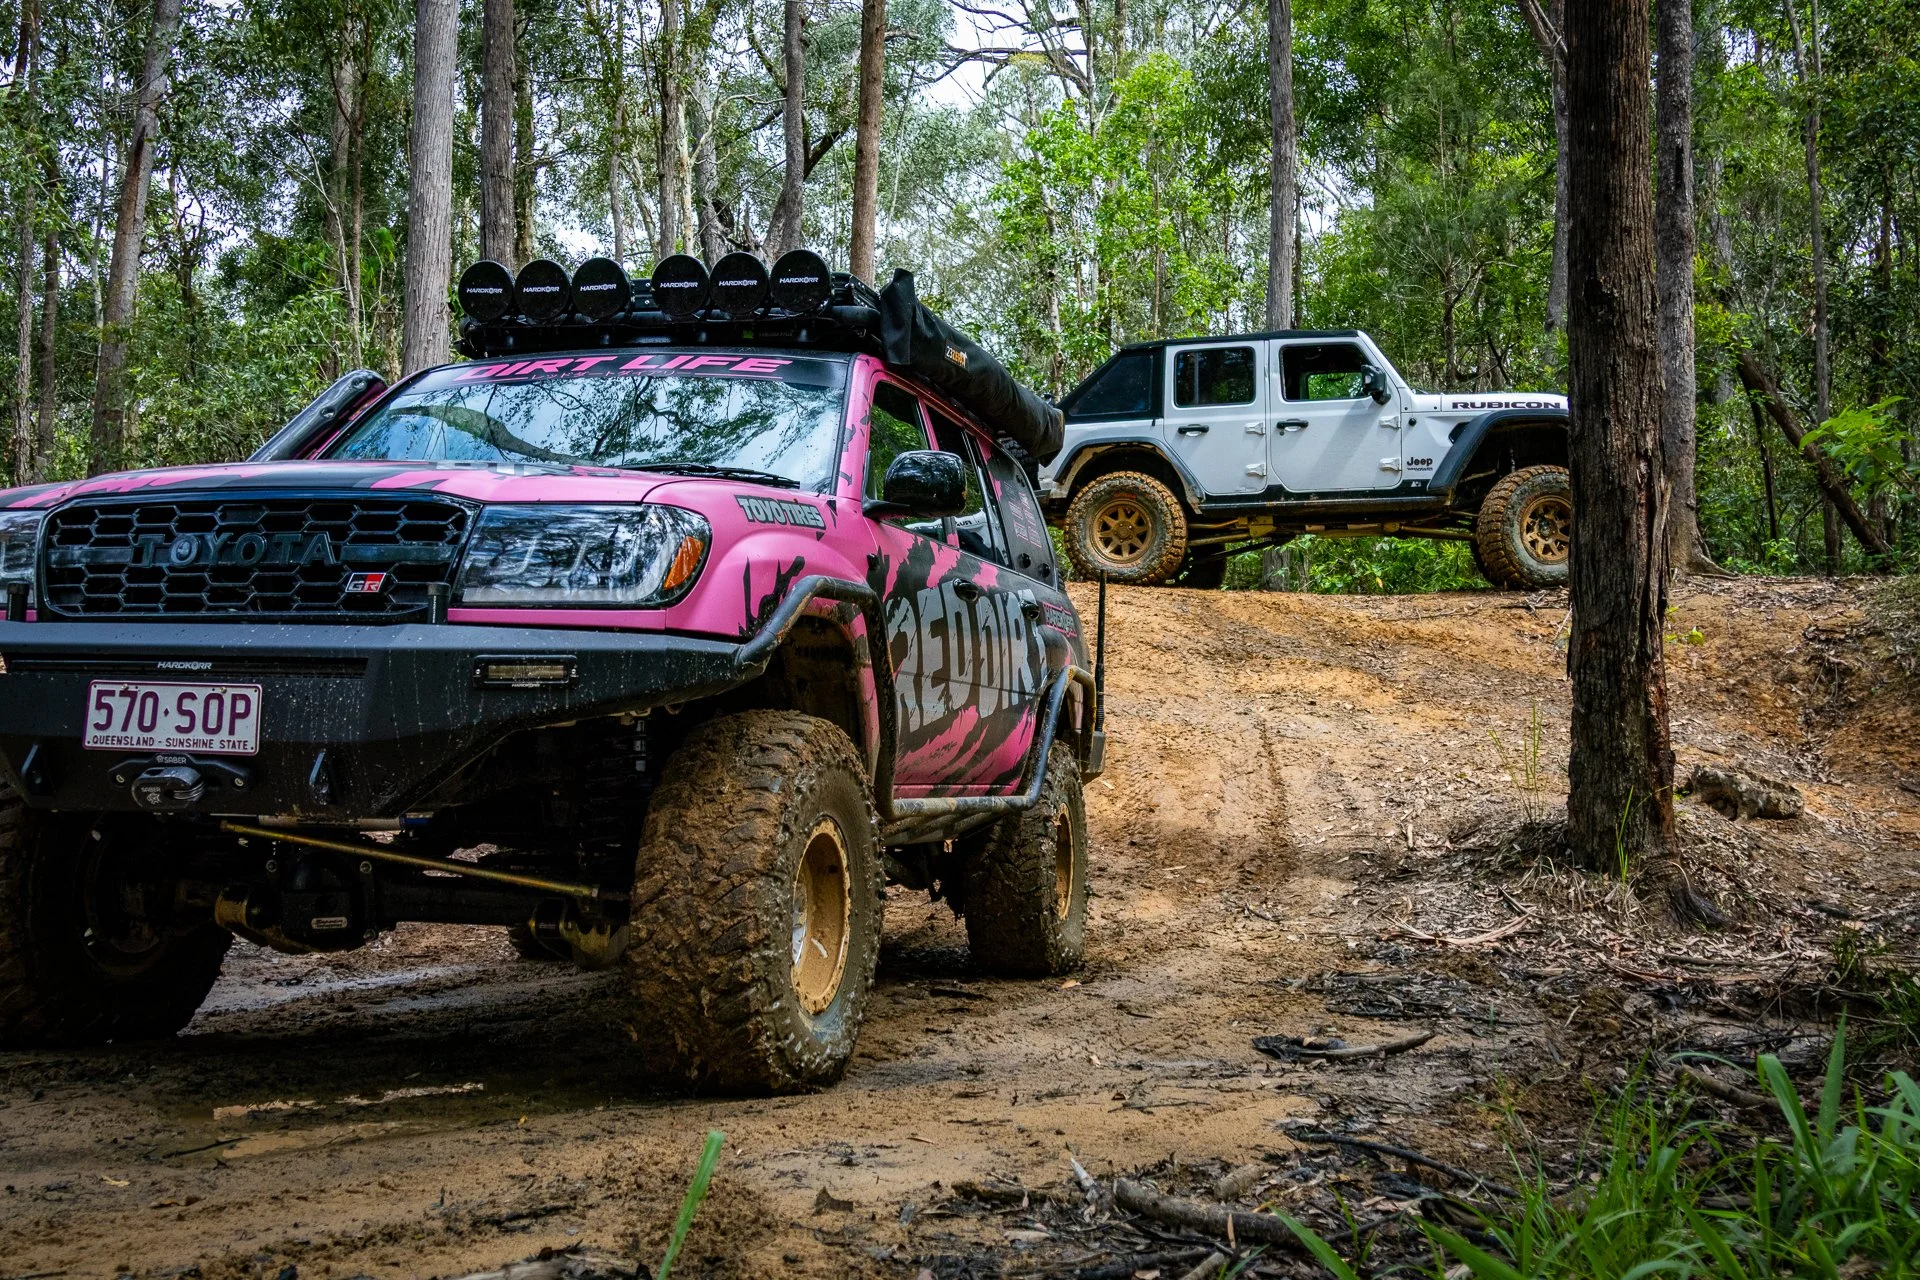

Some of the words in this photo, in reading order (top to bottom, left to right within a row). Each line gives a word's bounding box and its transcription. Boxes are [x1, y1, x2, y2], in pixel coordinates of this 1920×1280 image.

[718, 279, 758, 287] HARDKORR
[779, 276, 819, 284] HARDKORR
[523, 285, 560, 293] HARDKORR
[580, 283, 617, 292] HARDKORR
[660, 281, 698, 289] HARDKORR
[466, 287, 503, 295] HARDKORR
[454, 356, 618, 381] DIRT
[619, 355, 793, 373] LIFE
[1452, 401, 1560, 409] RUBICON
[1406, 456, 1433, 466] Jeep
[138, 532, 337, 567] TOYOTA
[348, 580, 380, 591] GR
[157, 661, 212, 670] HARDKORR
[92, 735, 155, 747] QUEENSLAND
[165, 737, 214, 749] SUNSHINE
[219, 739, 249, 750] STATE
[164, 756, 187, 764] SABER
